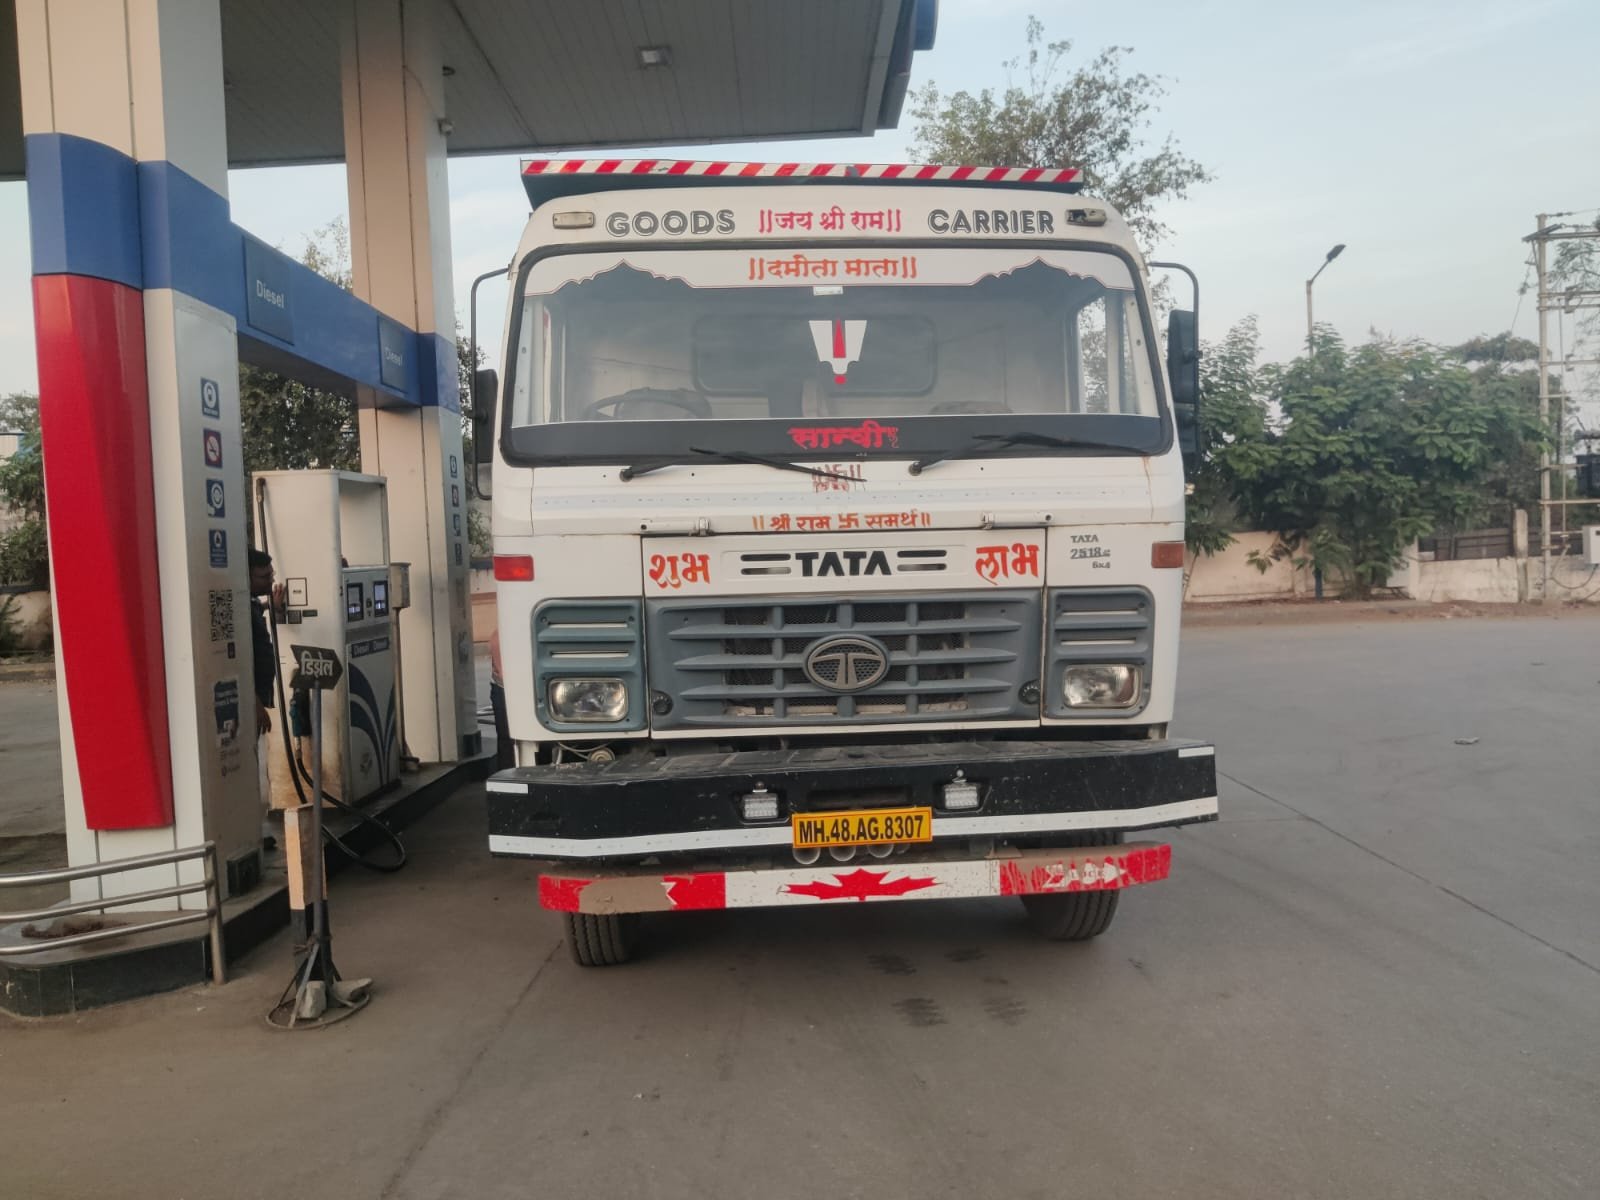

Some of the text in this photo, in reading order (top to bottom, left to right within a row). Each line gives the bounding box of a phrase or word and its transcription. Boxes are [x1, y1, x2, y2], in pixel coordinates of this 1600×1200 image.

[605, 209, 1055, 238] GOODS CARRIER
[819, 205, 845, 231] श्री
[256, 279, 285, 309] Diesel
[770, 513, 791, 533] श्री
[796, 515, 831, 532] राम
[1070, 534, 1099, 544] TATA
[649, 552, 711, 589] शुभ
[795, 550, 892, 577] TATA
[975, 543, 1039, 586] लाभ
[799, 815, 924, 844] MH.48.AG.8307
